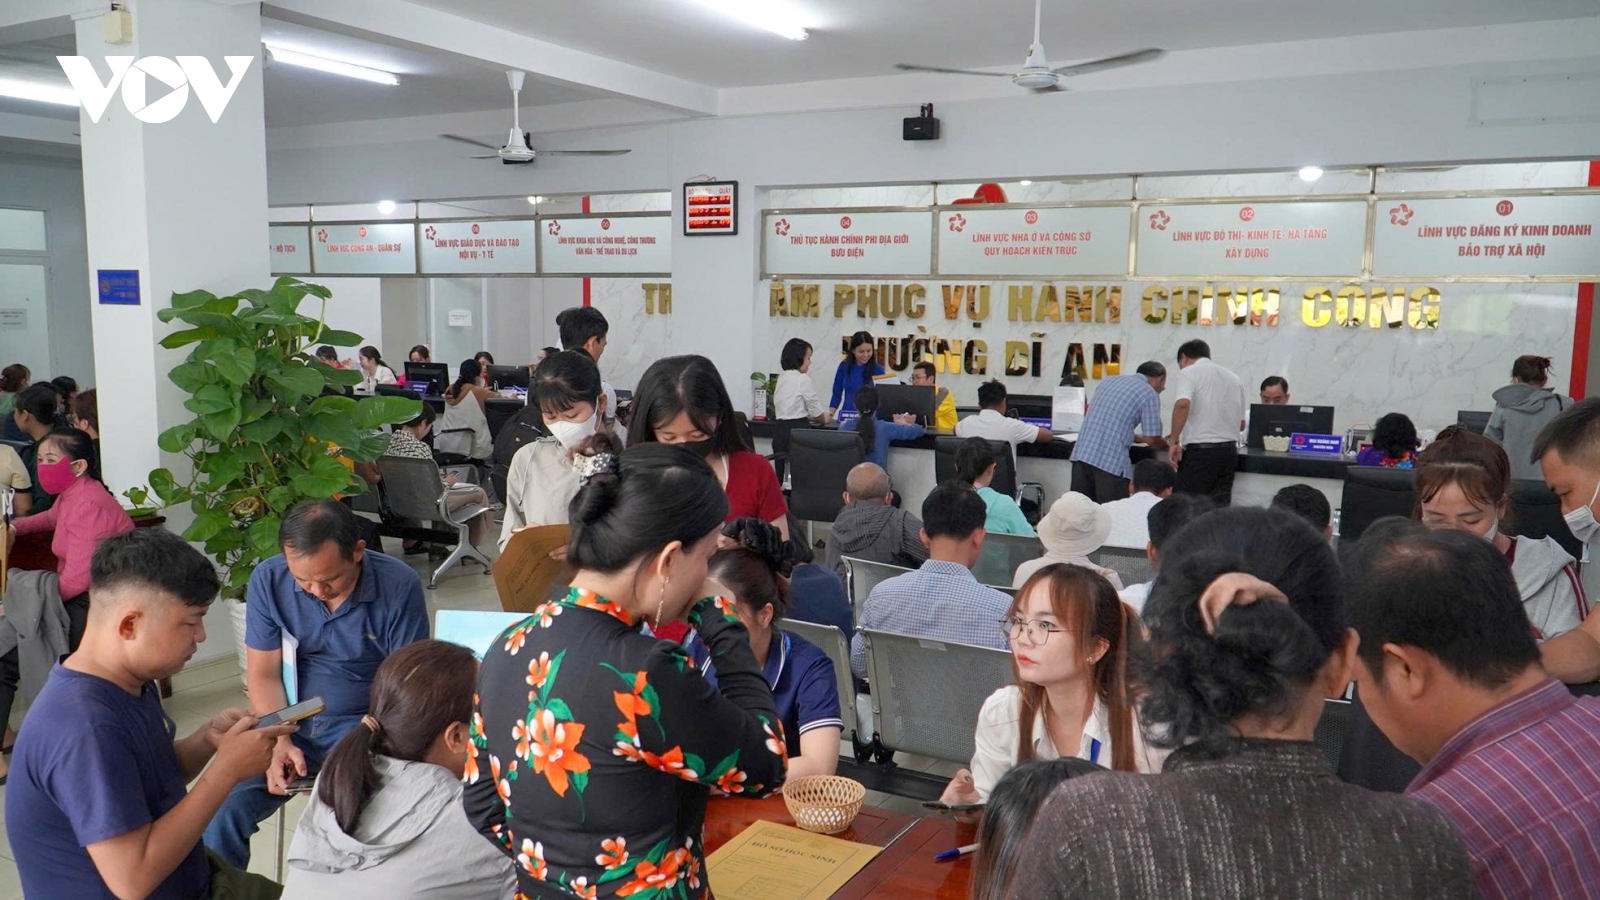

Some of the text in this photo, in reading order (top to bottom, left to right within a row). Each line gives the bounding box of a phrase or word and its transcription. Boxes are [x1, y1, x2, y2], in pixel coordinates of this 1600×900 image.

[1498, 203, 1511, 213] 01
[1026, 212, 1037, 222] 03
[1241, 210, 1253, 219] 02
[841, 218, 851, 228] 04
[1195, 230, 1212, 243] VỰC
[1247, 230, 1269, 240] KINH
[1418, 223, 1592, 240] LĨNH VỰC ĐĂNG KÝ KINH DOANH
[448, 238, 459, 249] VỰC
[460, 237, 473, 248] GIÁO
[474, 238, 486, 249] DỤC
[508, 237, 520, 249] TẠO
[805, 235, 819, 247] TỤC
[819, 233, 840, 245] HÀNH
[840, 233, 863, 244] CHÍNH
[864, 235, 878, 244] PHI
[879, 234, 892, 246] ĐỊA
[893, 232, 909, 244] GIỚI
[993, 232, 1009, 244] VỰC
[470, 250, 478, 260] VỤ
[984, 246, 1001, 256] QUY
[1458, 242, 1546, 258] BẢO TRỢ XÃ HỘI
[833, 283, 927, 326] PHỤC
[941, 284, 991, 328] VỤ
[1005, 331, 1046, 378] DĨ
[1062, 342, 1123, 380] AN
